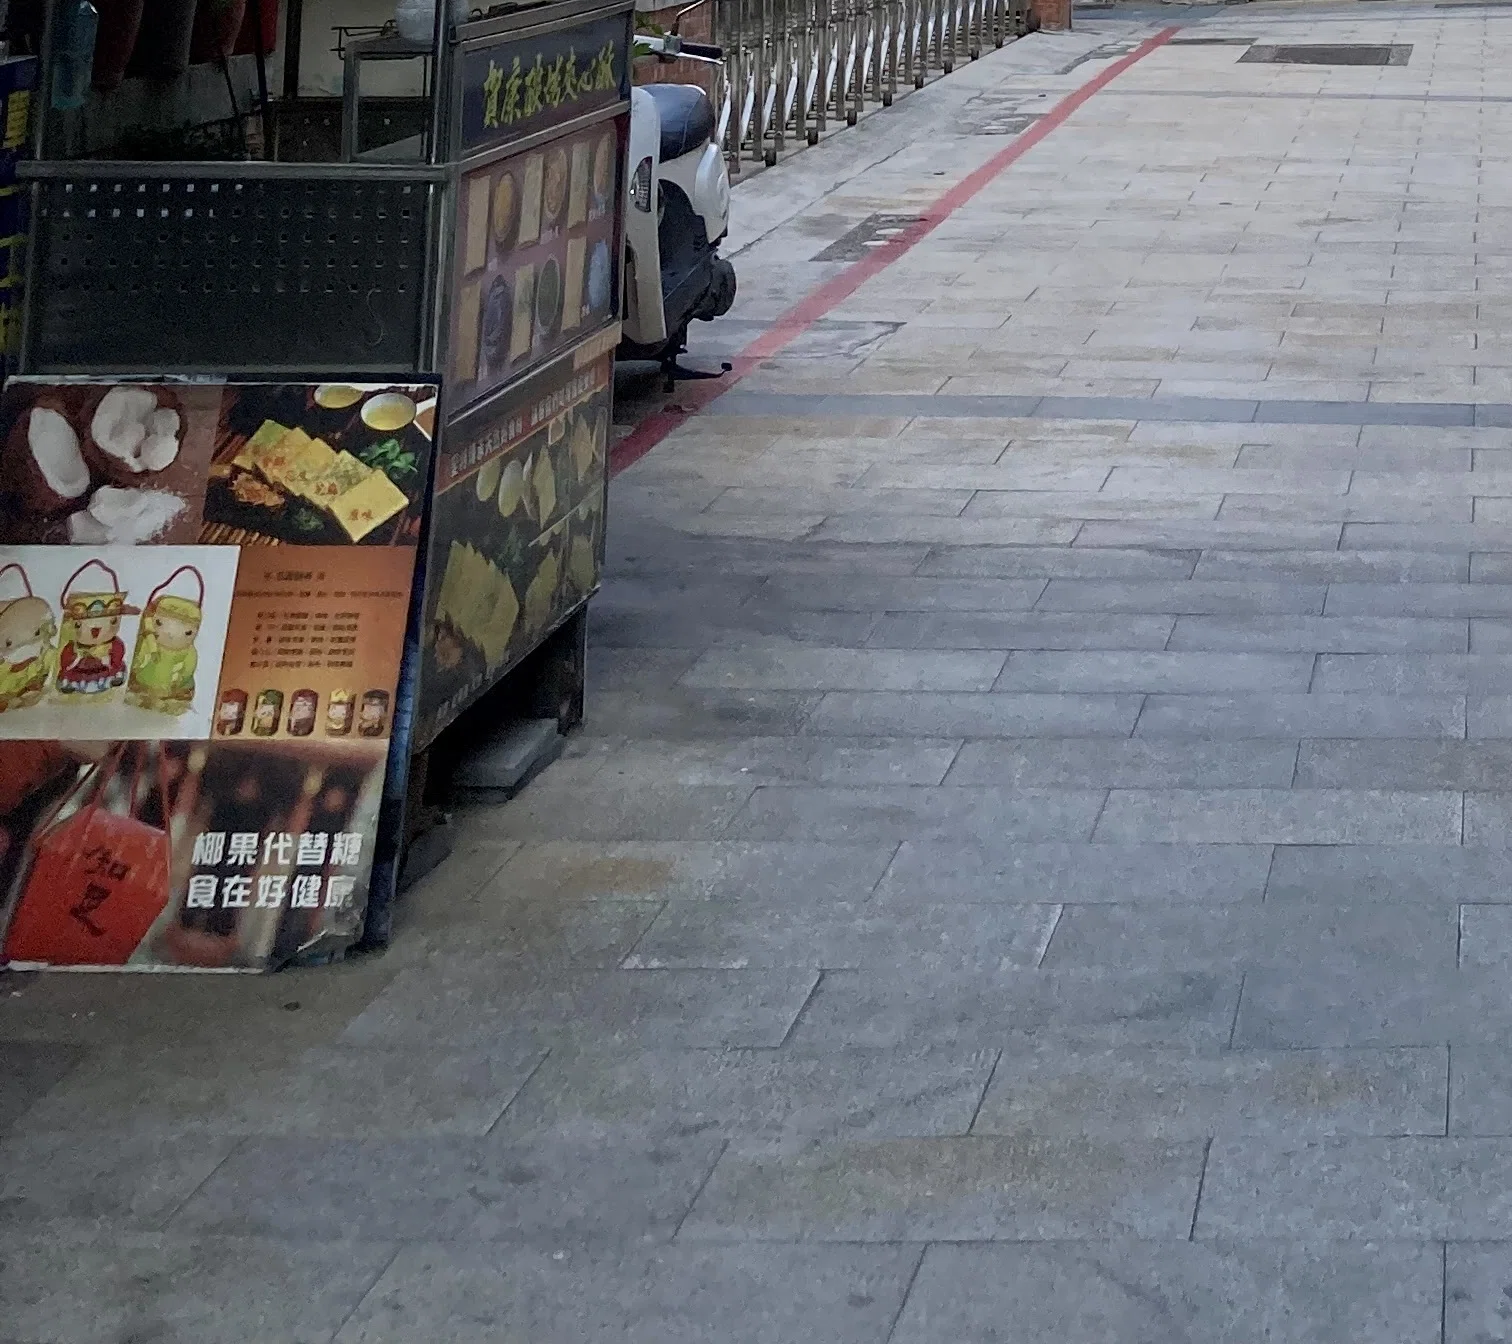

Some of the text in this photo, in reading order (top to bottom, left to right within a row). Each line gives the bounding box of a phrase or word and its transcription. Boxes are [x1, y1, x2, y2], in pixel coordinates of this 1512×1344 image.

[191, 831, 363, 866] 椰果代替糖
[186, 874, 357, 909] 食在好健康
